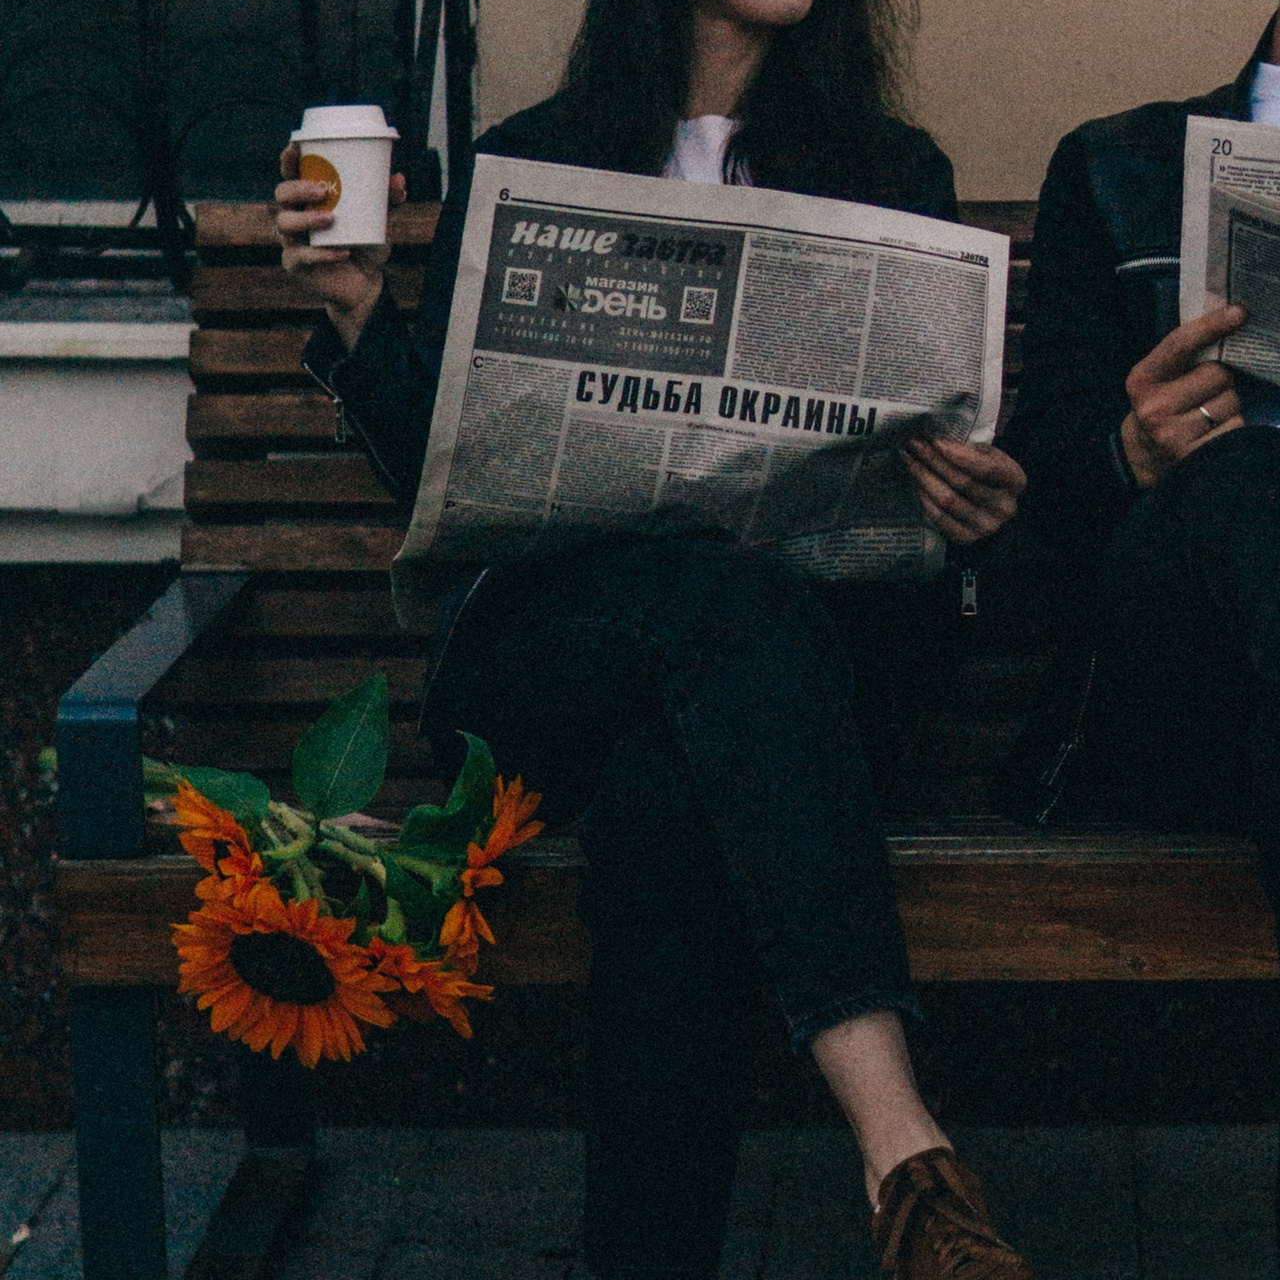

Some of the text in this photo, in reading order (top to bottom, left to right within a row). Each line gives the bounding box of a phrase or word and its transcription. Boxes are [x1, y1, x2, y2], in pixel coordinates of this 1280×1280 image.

[1211, 138, 1233, 157] 20
[499, 188, 510, 202] 6
[575, 370, 878, 436] СУДЬБА ОКРАИНЫ
